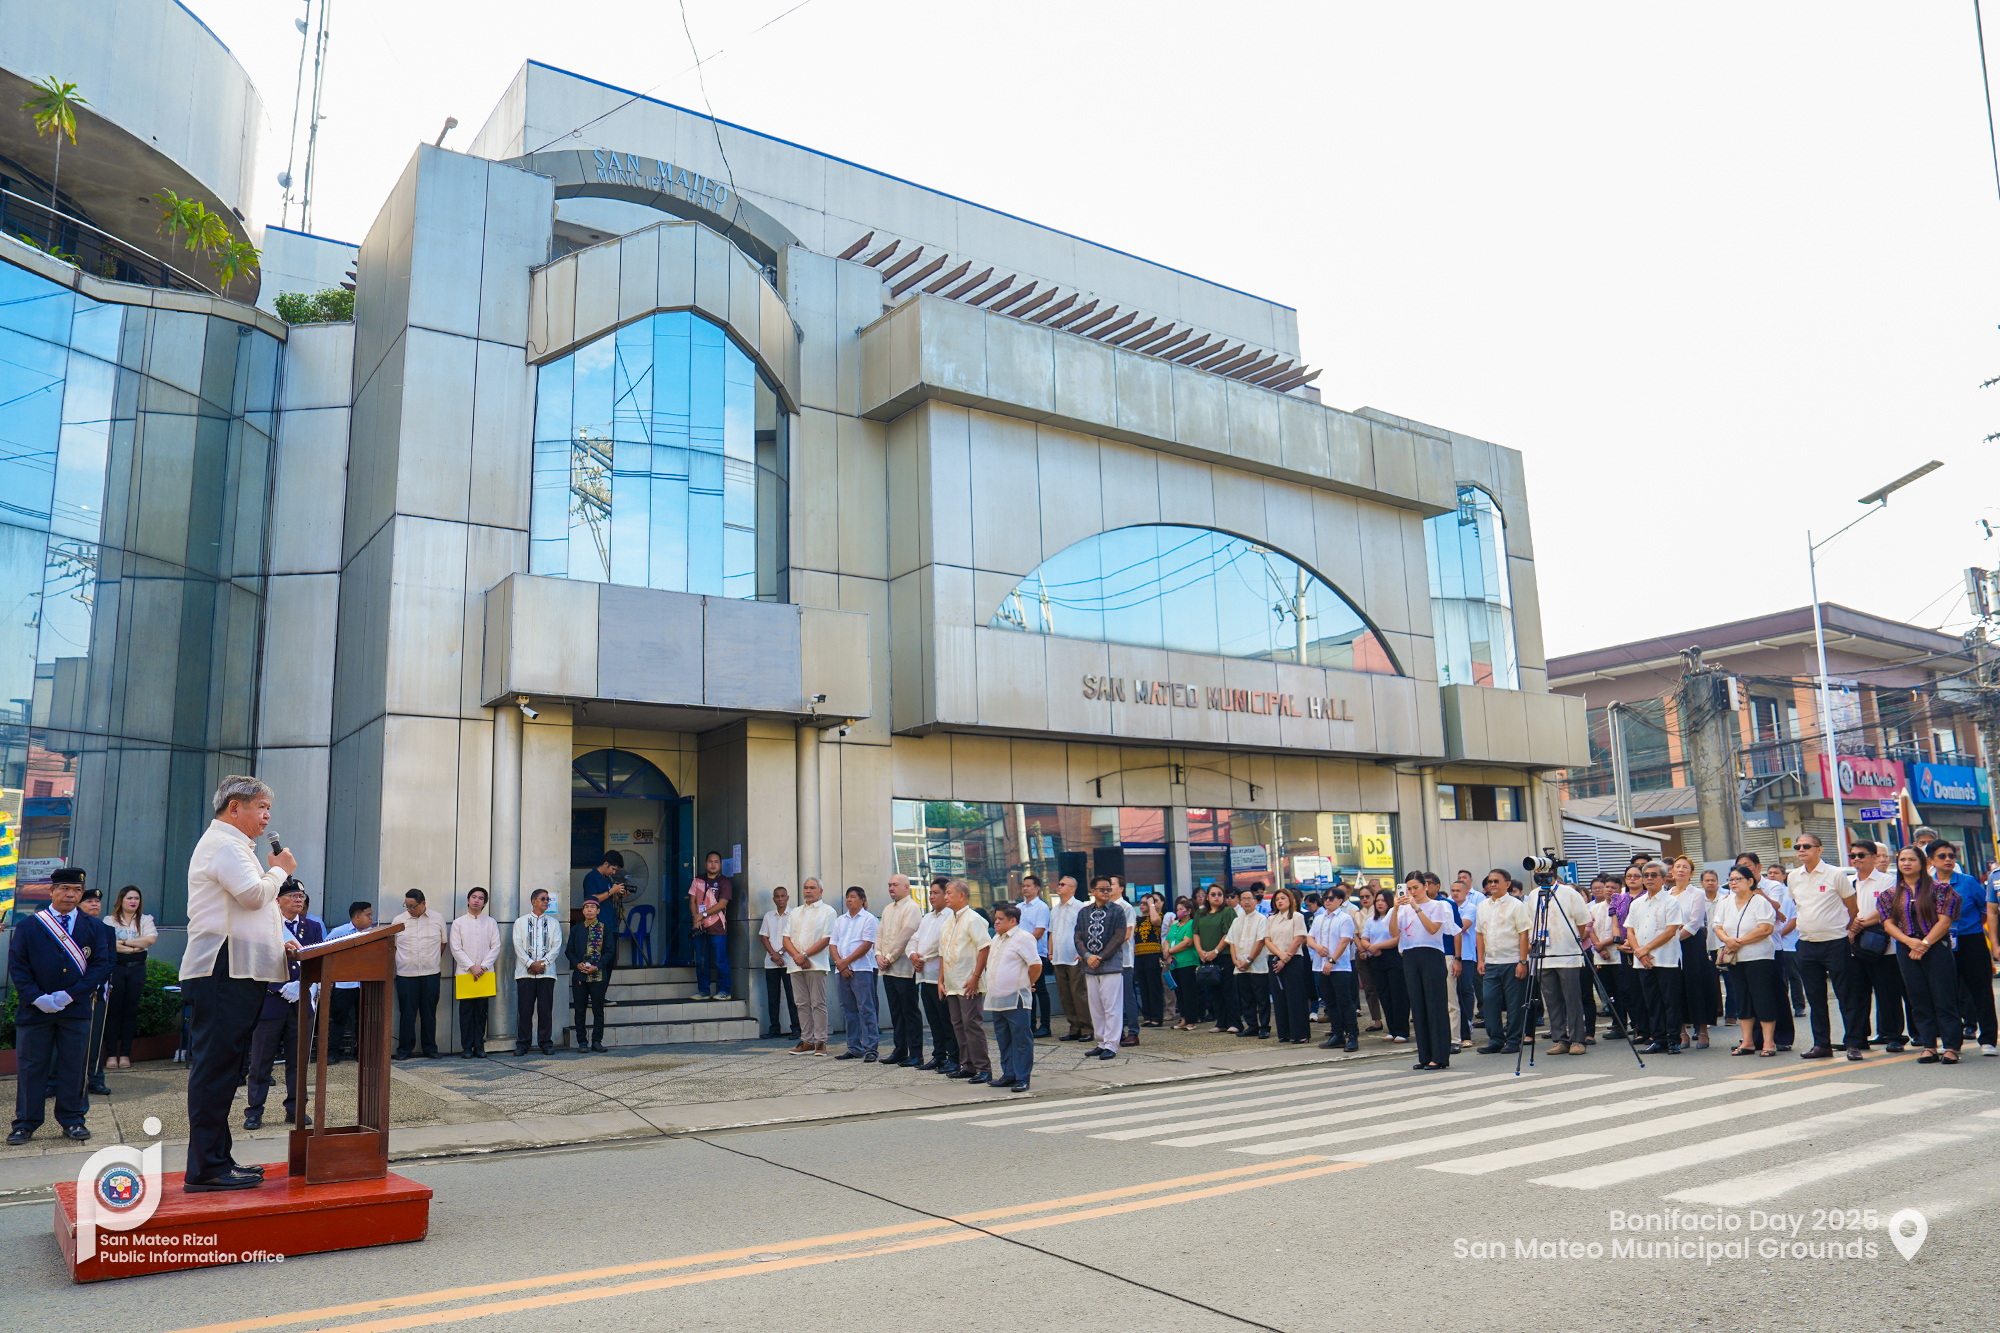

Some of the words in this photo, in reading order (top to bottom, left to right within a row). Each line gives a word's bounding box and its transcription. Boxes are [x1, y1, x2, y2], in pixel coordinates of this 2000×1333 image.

[594, 149, 640, 173] SAN
[656, 160, 728, 204] MATEO
[597, 168, 677, 196] MUNICIPAL
[1083, 674, 1125, 702] SAN
[1135, 680, 1199, 709] MATEO
[1207, 686, 1302, 718] MUNICIPAL
[1308, 696, 1354, 722] HALL
[1855, 771, 1874, 786] Lola
[1933, 779, 1976, 801] Domino's
